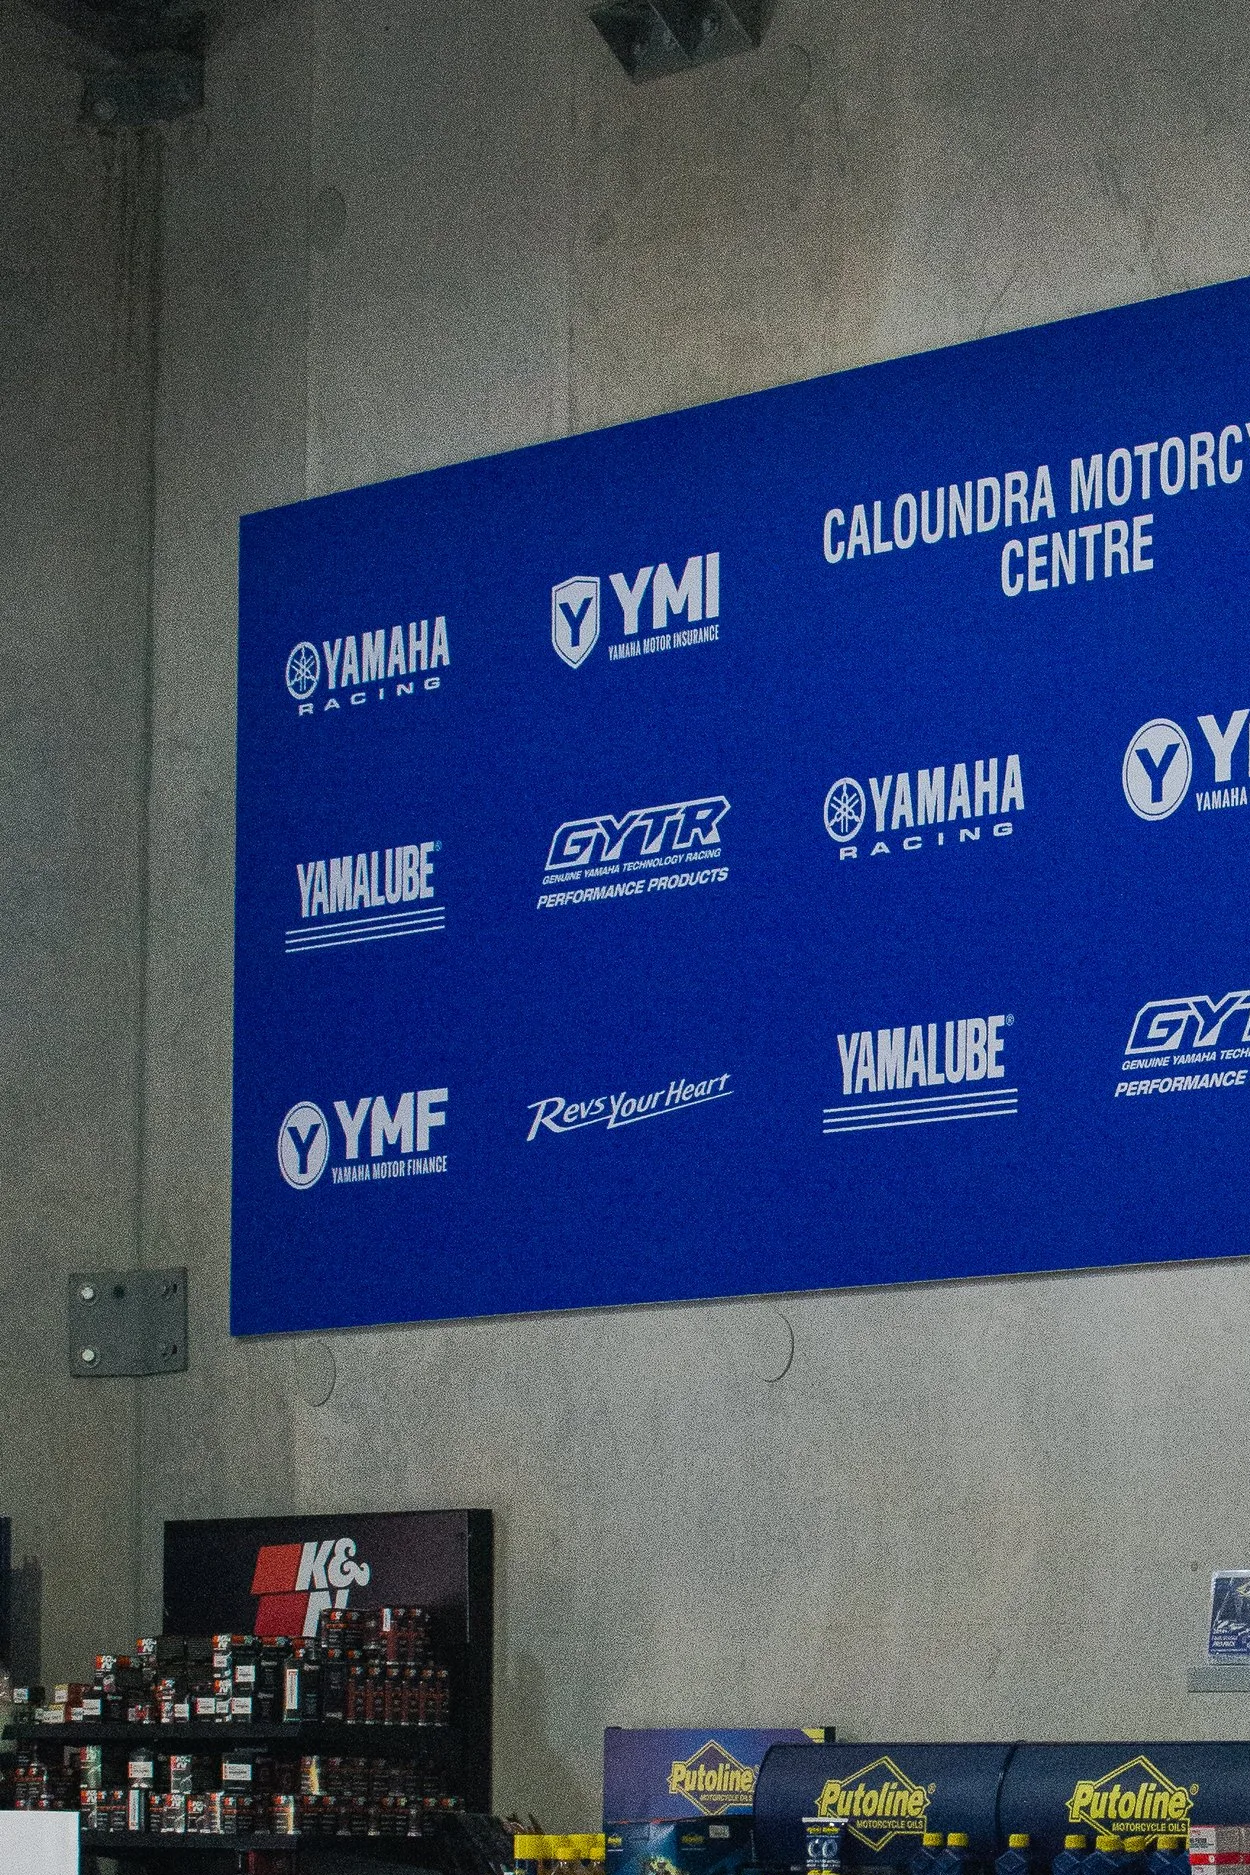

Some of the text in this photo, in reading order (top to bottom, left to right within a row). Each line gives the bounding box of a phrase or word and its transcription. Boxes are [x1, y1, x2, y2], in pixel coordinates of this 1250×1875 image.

[823, 464, 1056, 564] CALOUNDRA
[1000, 513, 1154, 597] CENTRE
[608, 551, 720, 636] YMI
[322, 615, 450, 690] YAMAHA
[608, 624, 719, 660] YAMAHA MOTOR INSURANCE
[298, 676, 440, 716] RACING
[868, 754, 1025, 833] YAMAHA
[1195, 786, 1248, 811] YAMAHA
[544, 795, 731, 871] GYTR
[839, 822, 1013, 861] RACING
[536, 866, 729, 909] PERFORMANCE PRODUCTS
[1121, 1056, 1170, 1071] GENUINE
[1173, 1051, 1217, 1065] YAMAHA
[1114, 1069, 1248, 1098] PERFORMANCE
[333, 1087, 449, 1160] YMF
[526, 1072, 732, 1142] Revs Your Heart
[331, 1155, 447, 1183] YAMAHA MOTOR FINANCE
[670, 1762, 755, 1792] Putoline
[821, 1779, 928, 1818] Putoline
[1072, 1781, 1192, 1820] Putoline
[856, 1817, 924, 1831] MOTORCYCLE OILS
[1111, 1821, 1188, 1834] MOTORCYCLE OILS
